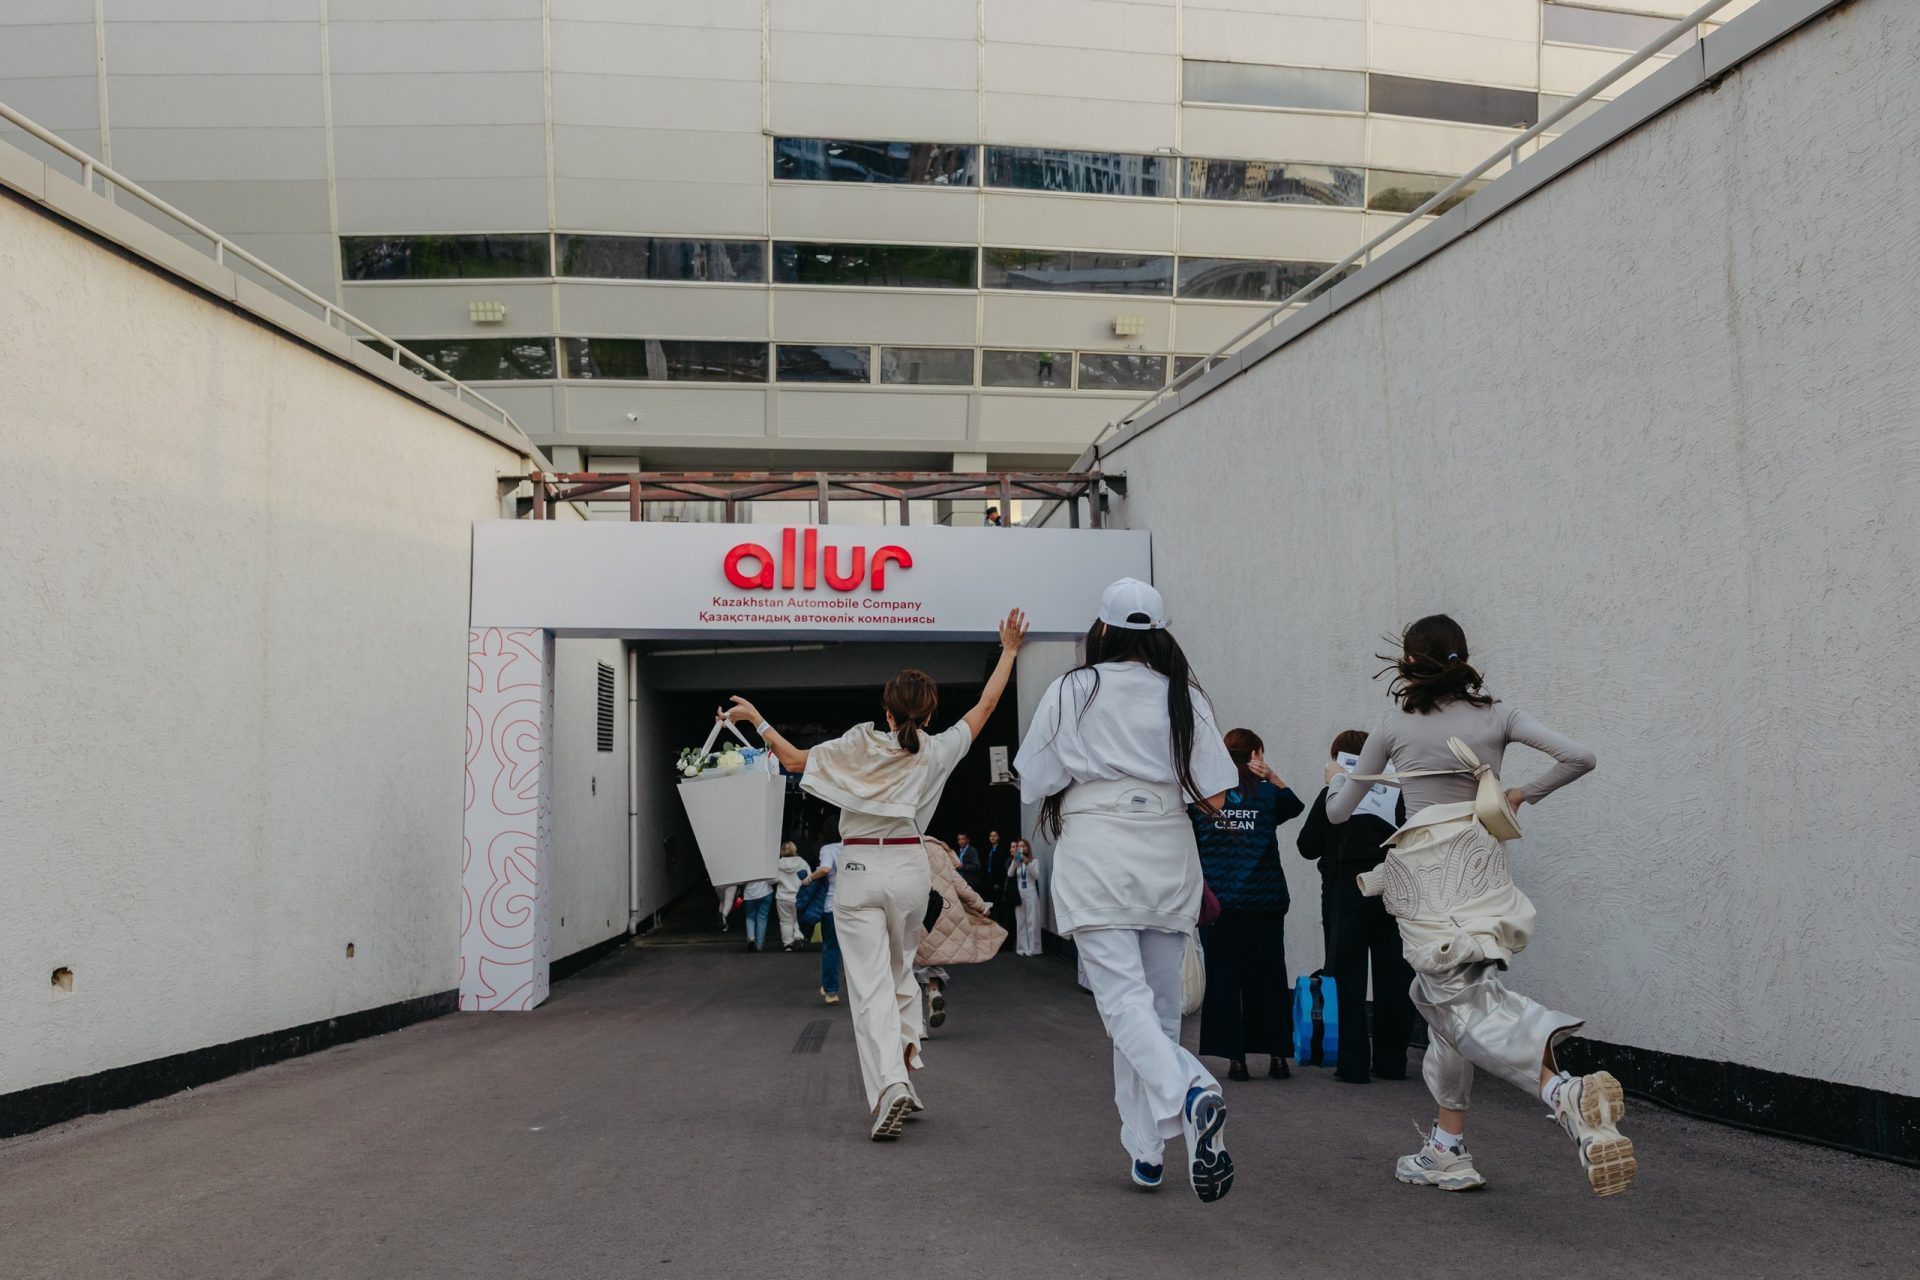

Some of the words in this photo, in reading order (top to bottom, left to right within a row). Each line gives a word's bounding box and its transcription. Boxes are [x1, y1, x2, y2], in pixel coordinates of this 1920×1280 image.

[723, 527, 913, 592] allur
[712, 596, 784, 608] Kazakhstan
[787, 597, 859, 609] Automobile
[862, 598, 922, 611] Company
[699, 611, 791, 624] Қазақстандық
[794, 612, 854, 623] автокөлік
[858, 615, 935, 624] компаниясы
[1212, 809, 1259, 819] XPERT
